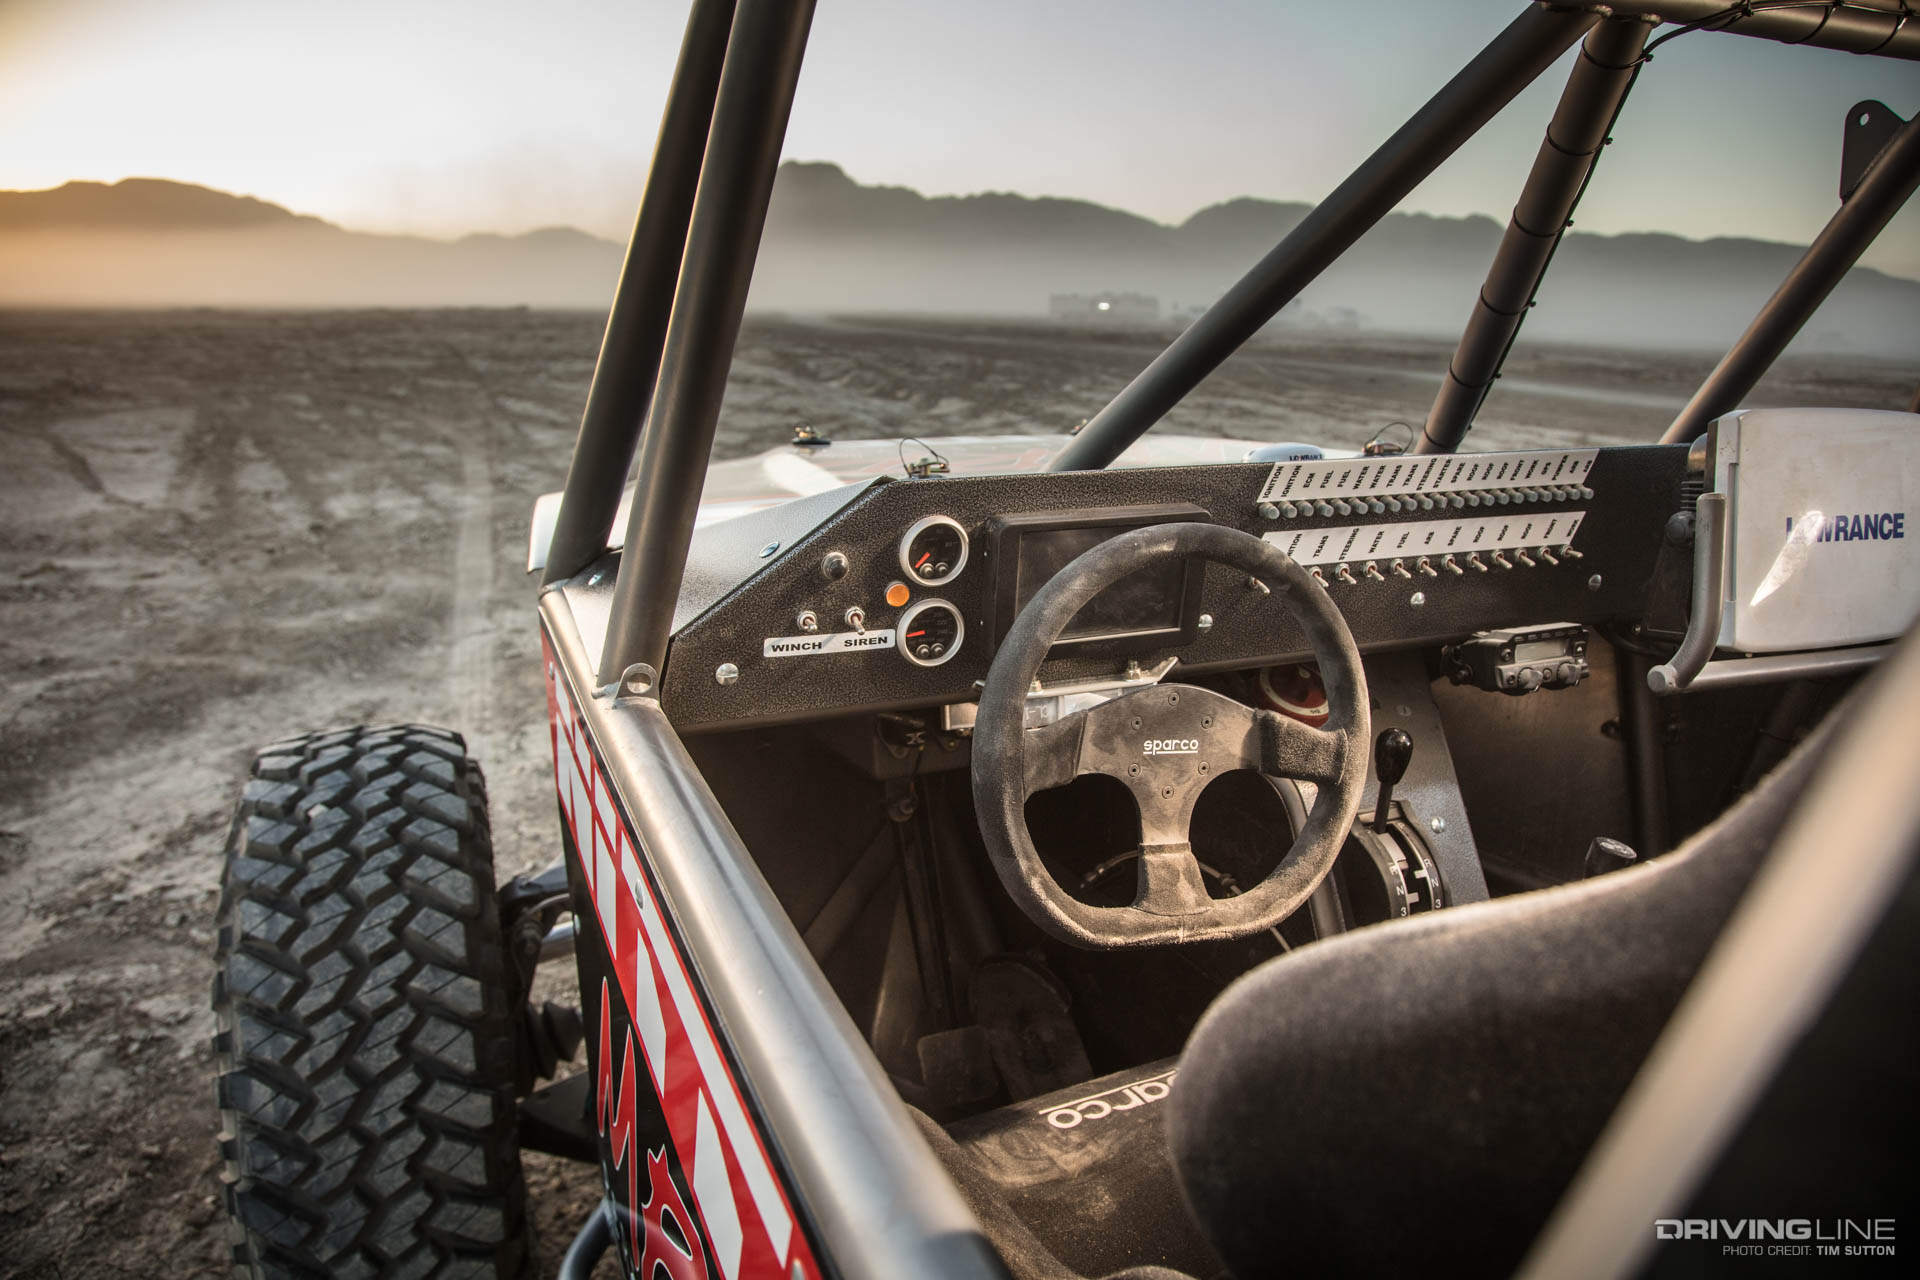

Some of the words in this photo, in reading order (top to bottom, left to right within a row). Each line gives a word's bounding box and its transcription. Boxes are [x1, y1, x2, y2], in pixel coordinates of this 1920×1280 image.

[1320, 470, 1334, 488] FUEL
[1337, 470, 1351, 487] FUEL
[1352, 466, 1370, 490] WATER
[1369, 465, 1386, 489] WATER
[1386, 465, 1402, 488] TRANS
[1402, 464, 1419, 487] TRANS
[1416, 458, 1437, 491] STEERING
[1433, 458, 1453, 488] STARTER
[1450, 462, 1466, 483] SPARE
[1467, 463, 1479, 481] ROOF
[1482, 463, 1494, 480] ROOF
[1496, 462, 1509, 479] ROOF
[1262, 466, 1284, 498] IGNITION
[1280, 465, 1302, 497] IGNITION
[1303, 473, 1316, 488] ECM
[1448, 526, 1462, 546] SPARE
[1473, 526, 1485, 543] ROOF
[1497, 525, 1509, 541] ROOF
[1521, 523, 1532, 539] ROOF
[1786, 513, 1905, 542] LWRANCE
[1287, 533, 1303, 557] NITION
[1313, 535, 1329, 558] TRANS
[1339, 528, 1360, 560] STEERING
[1368, 531, 1384, 553] WATER
[1397, 532, 1410, 548] FUEL
[771, 641, 822, 653] WINCH
[844, 636, 888, 647] SIREN
[1143, 739, 1199, 755] sparco
[1396, 886, 1405, 896] N
[1431, 878, 1439, 888] N
[1400, 906, 1407, 917] 3
[1435, 899, 1442, 909] 3
[1047, 1074, 1177, 1129] arco
